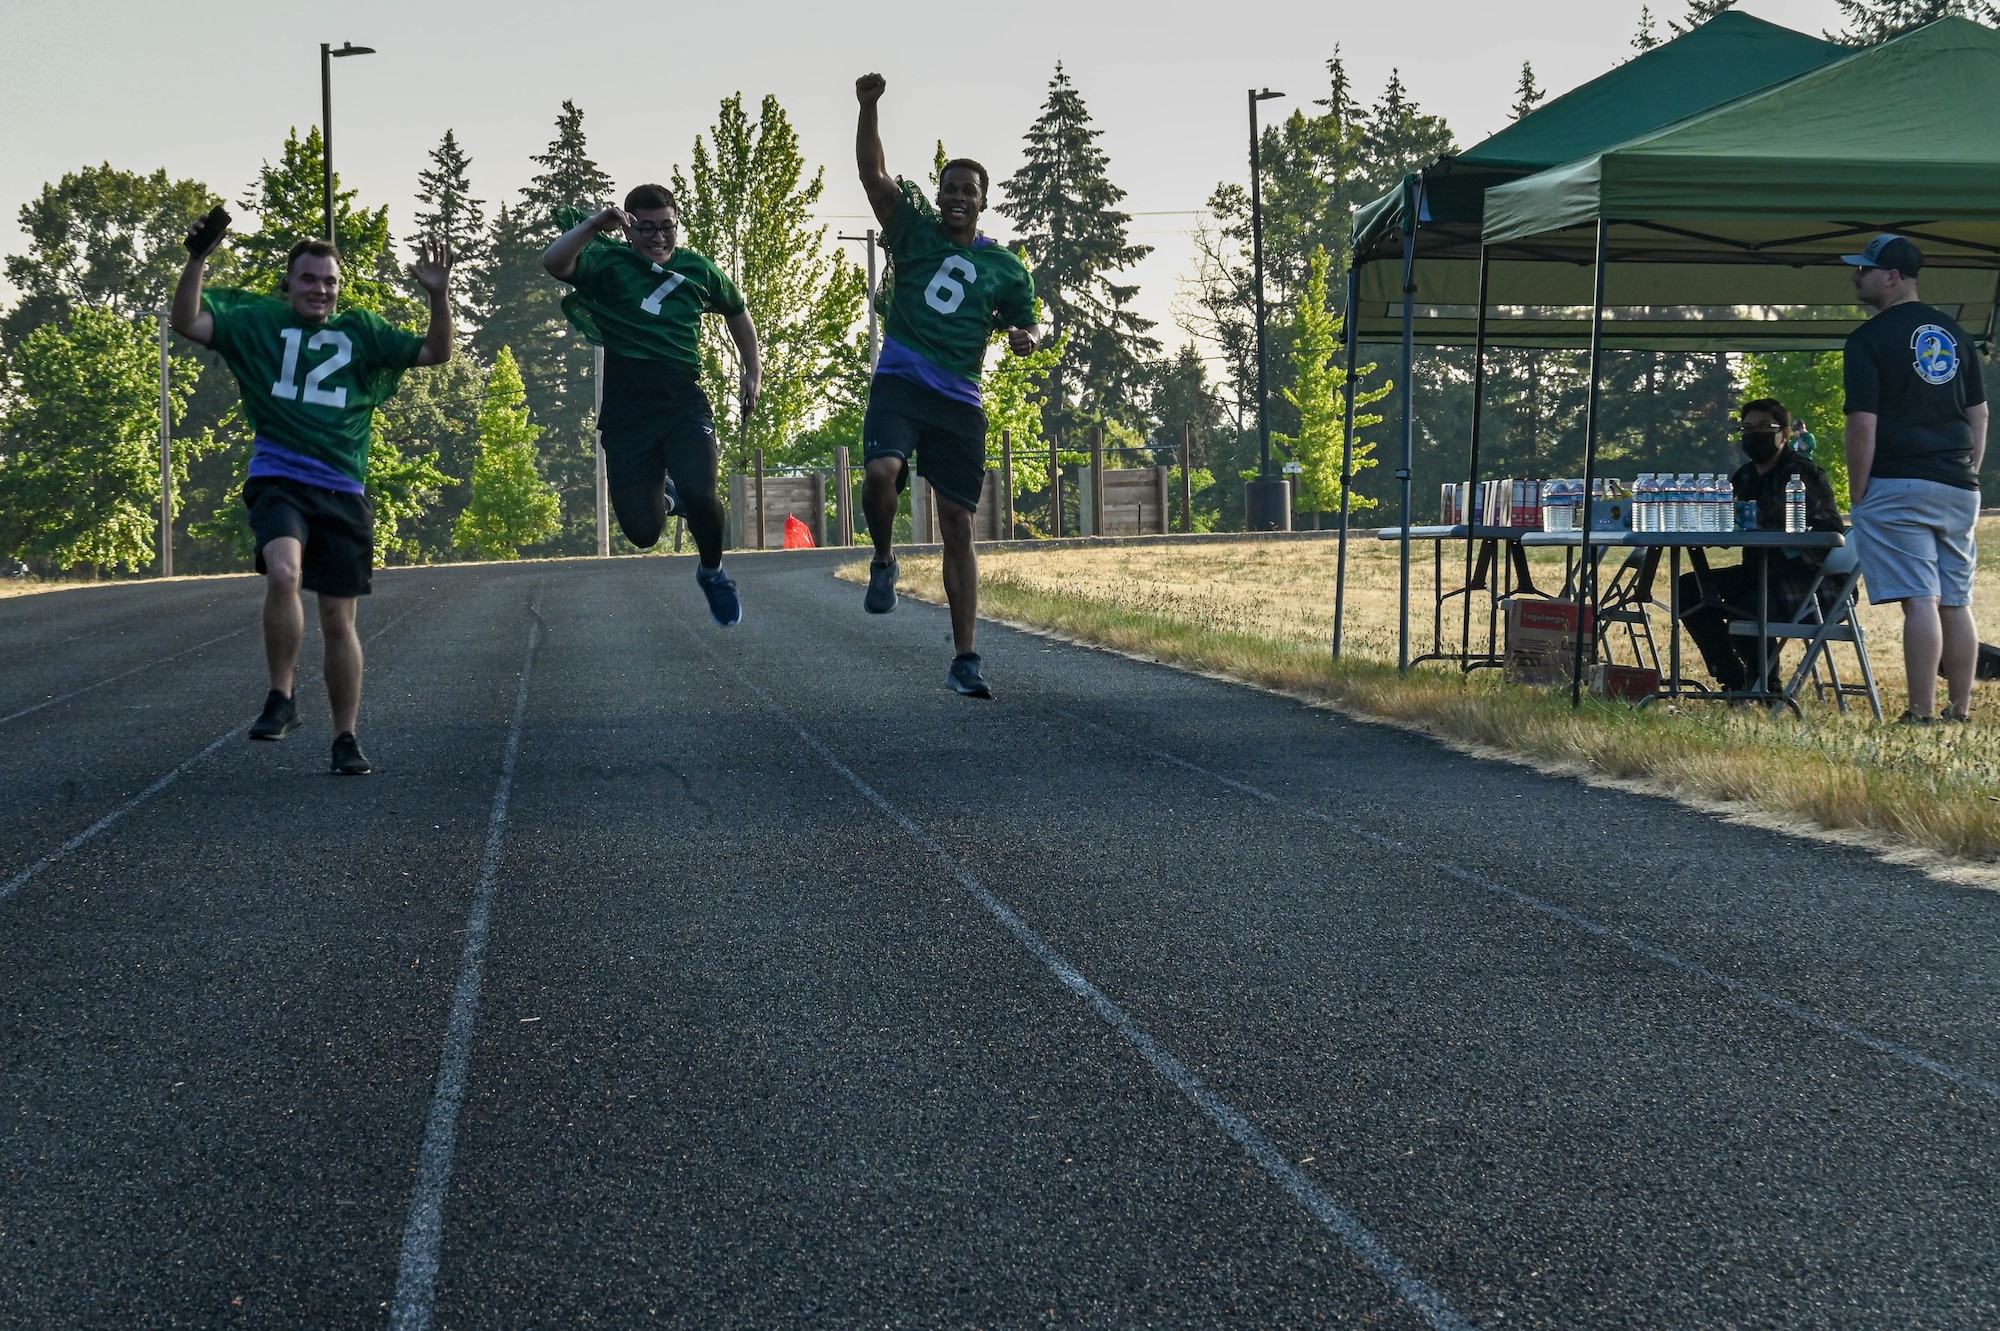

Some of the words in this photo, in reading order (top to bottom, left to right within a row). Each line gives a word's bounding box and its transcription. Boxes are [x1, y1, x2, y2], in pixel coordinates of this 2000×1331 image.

[640, 261, 685, 315] 7
[924, 254, 977, 315] 6
[271, 327, 353, 408] 12
[1523, 612, 1566, 624] tagalongs
